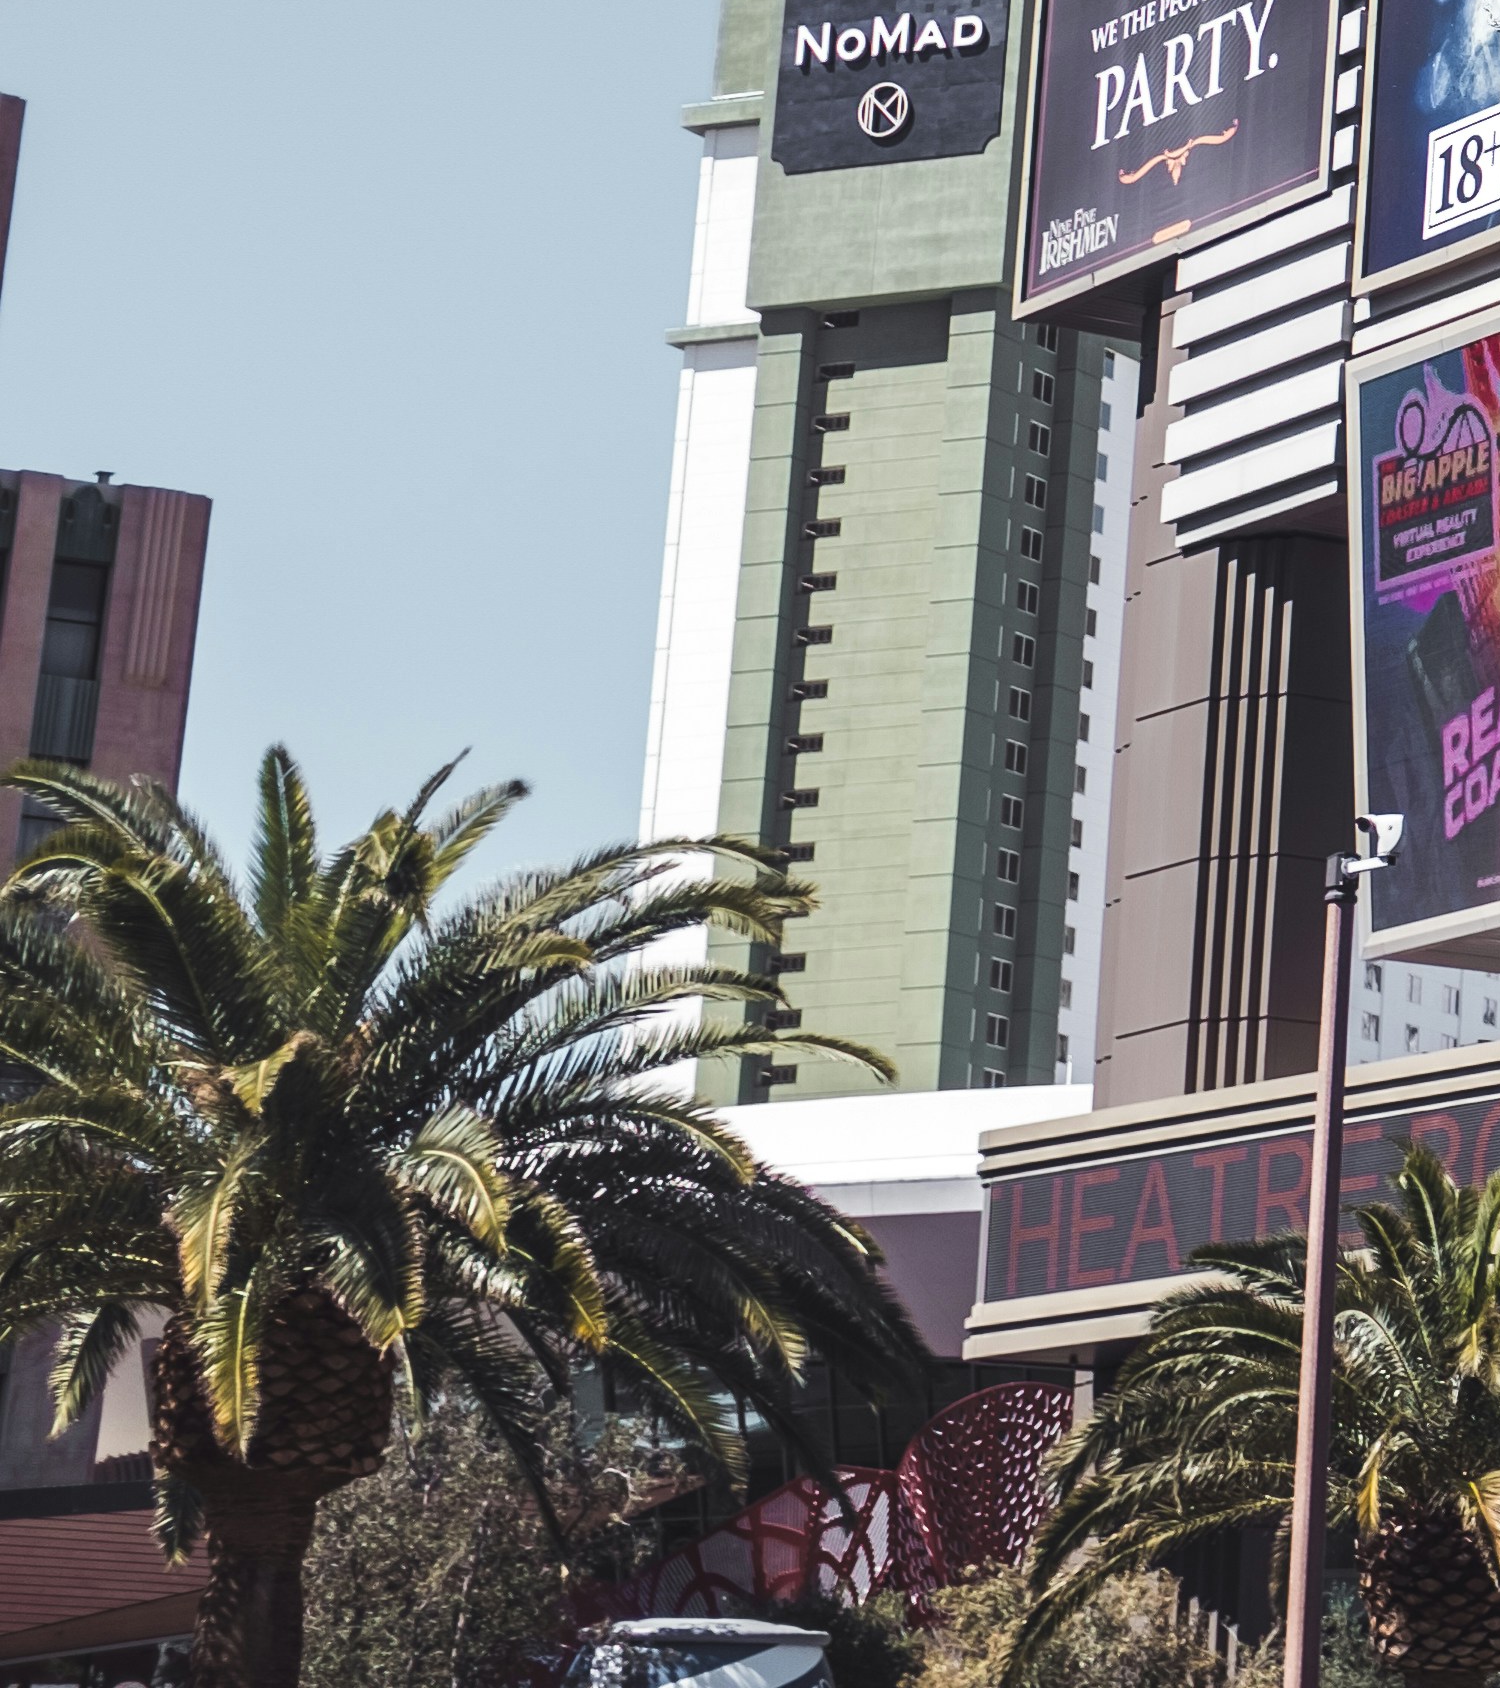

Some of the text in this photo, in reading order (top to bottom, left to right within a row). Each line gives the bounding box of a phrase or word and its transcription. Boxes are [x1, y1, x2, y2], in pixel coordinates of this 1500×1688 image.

[1091, 18, 1118, 53] WE
[1121, 1, 1157, 40] THE
[1039, 214, 1120, 276] IRISHMEN
[1381, 440, 1490, 506] BIG APPLE
